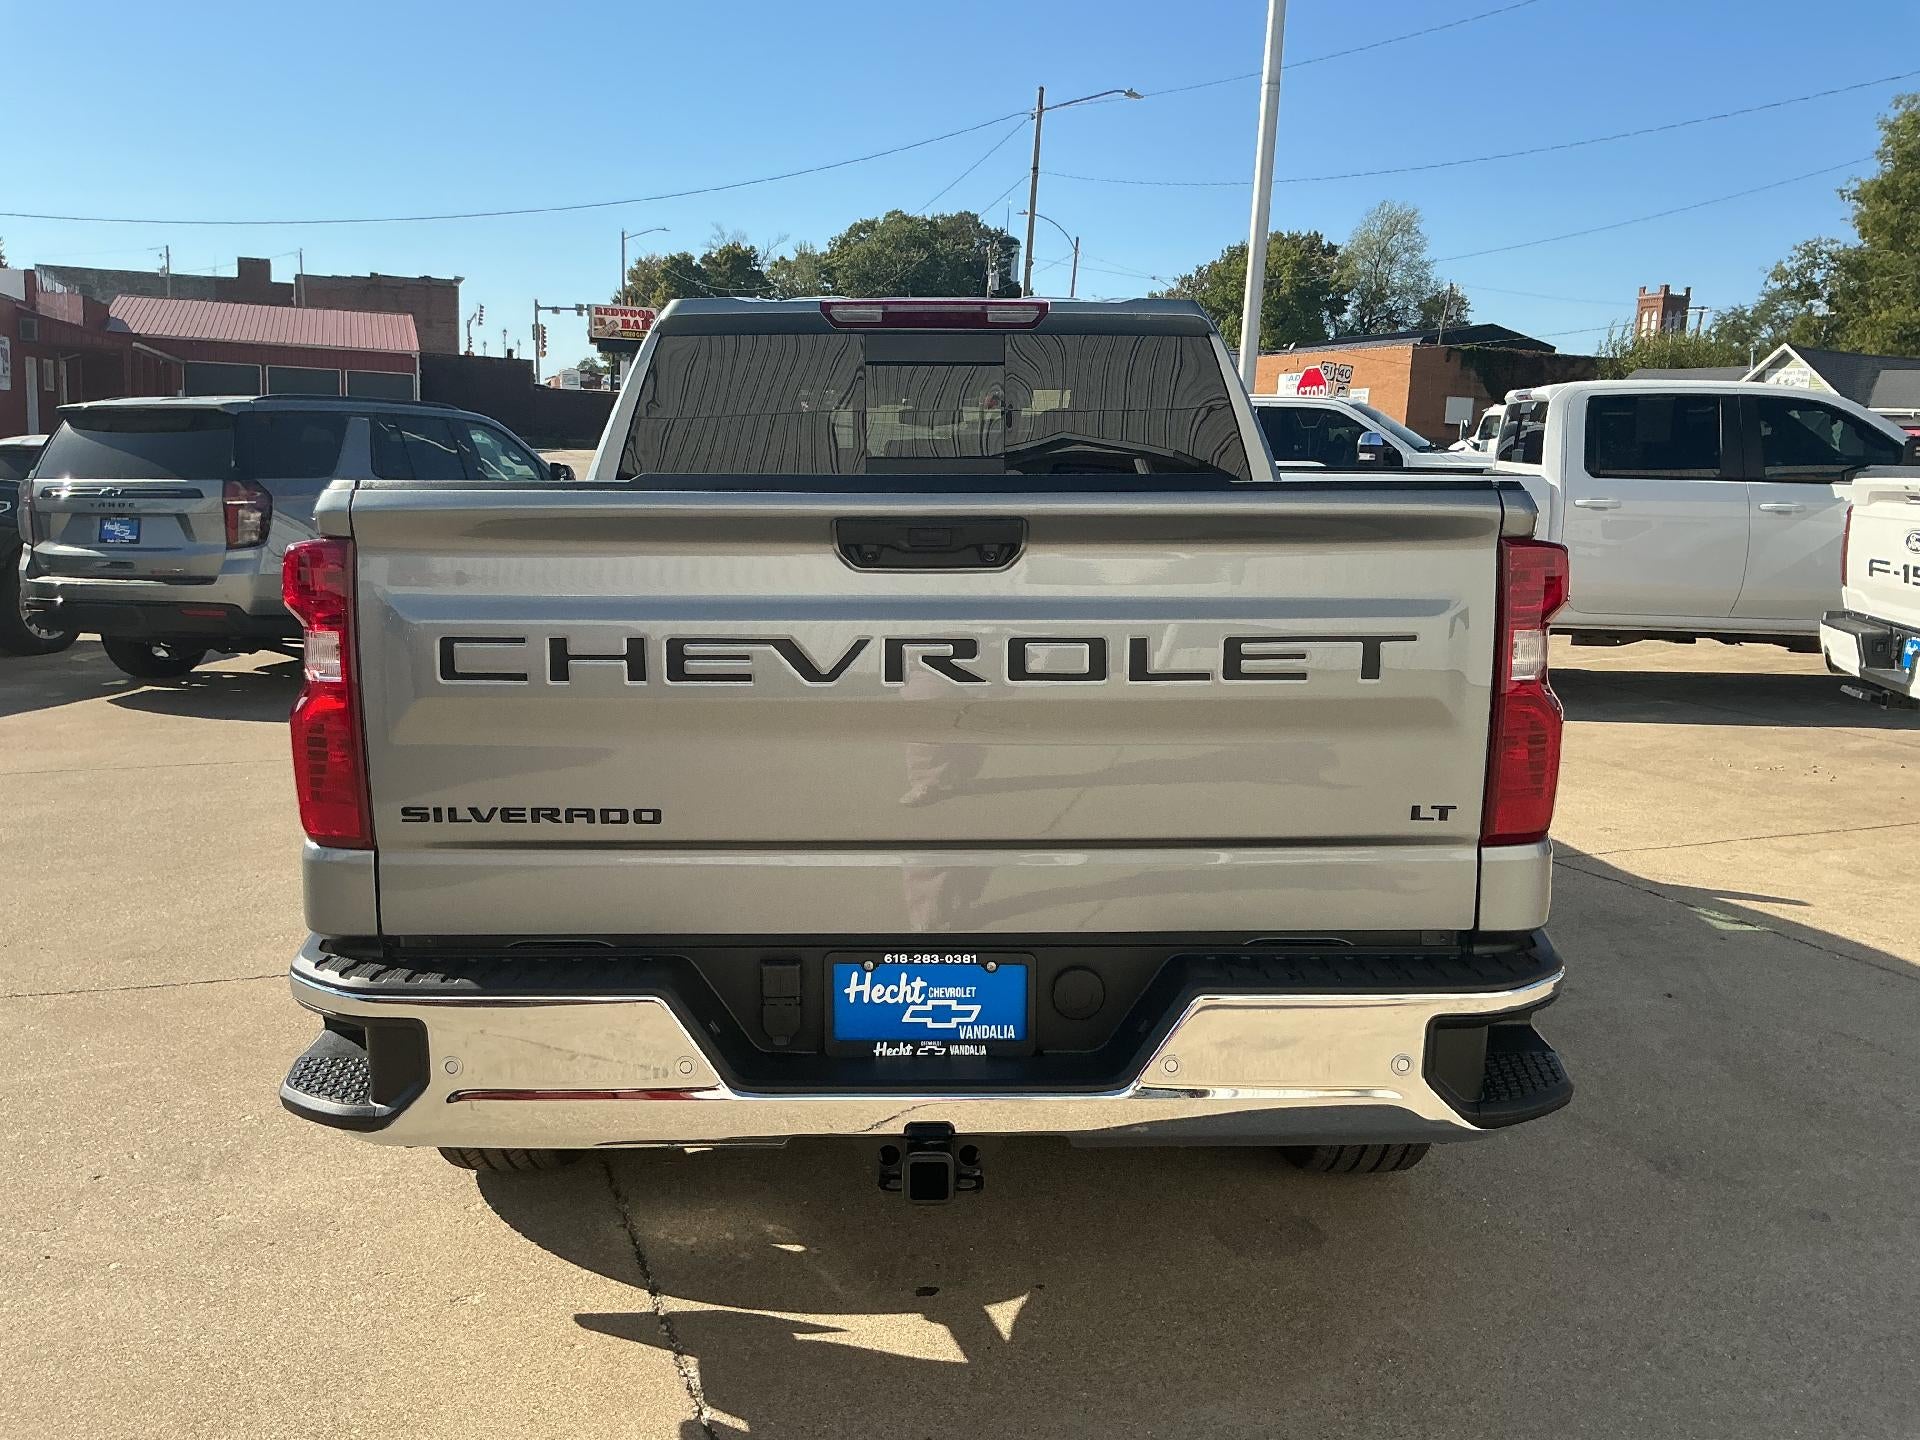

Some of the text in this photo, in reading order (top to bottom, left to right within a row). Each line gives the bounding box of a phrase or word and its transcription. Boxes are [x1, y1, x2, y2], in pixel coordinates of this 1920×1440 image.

[595, 307, 655, 319] REDWOOD
[1323, 366, 1333, 376] 51
[1338, 369, 1350, 379] 40
[437, 634, 1418, 686] CHEVROLET
[401, 806, 662, 825] SILVERADO
[1410, 805, 1457, 821] LT
[883, 953, 978, 964] 618-283-0381
[844, 970, 977, 1005] Hecht CHEVROLET
[958, 1024, 1016, 1040] VANDALIA
[873, 1041, 987, 1057] Hecht VANDALIA
